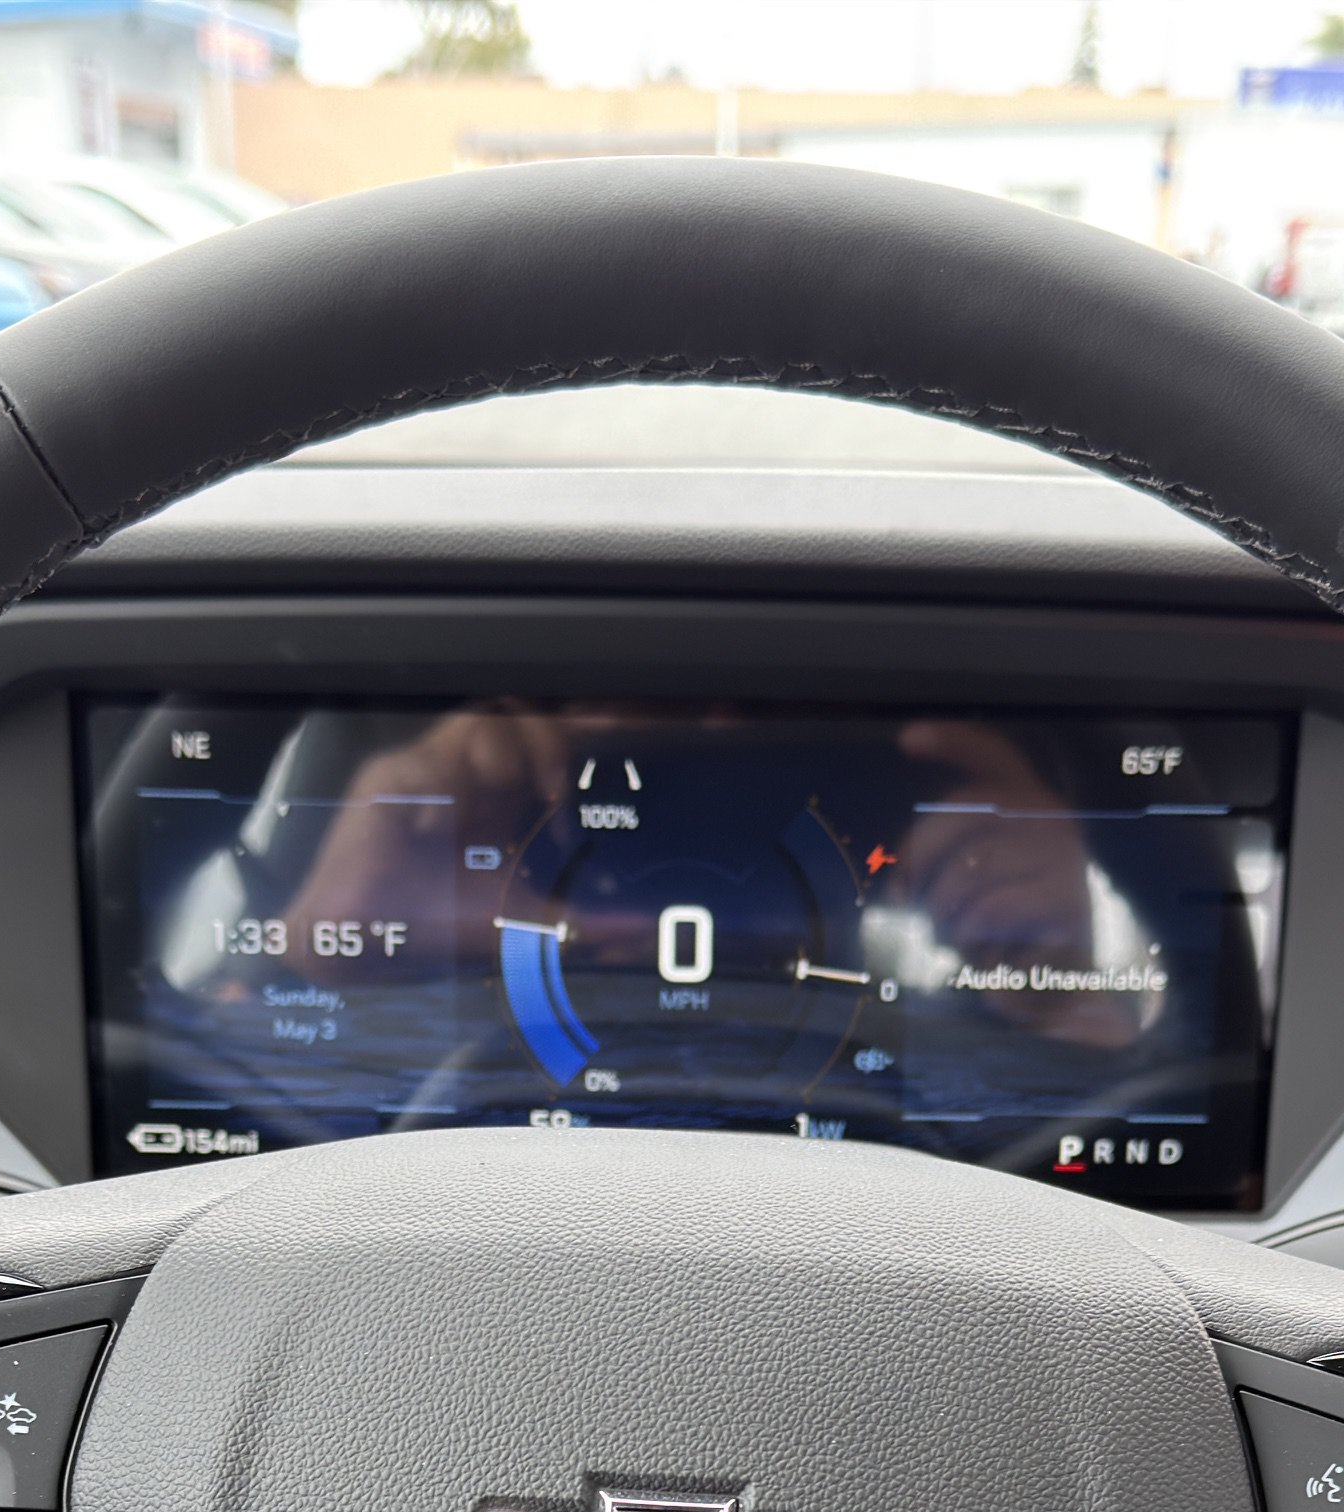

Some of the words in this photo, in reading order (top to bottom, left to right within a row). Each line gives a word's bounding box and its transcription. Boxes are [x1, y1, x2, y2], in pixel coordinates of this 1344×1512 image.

[172, 731, 210, 759] NE
[1122, 747, 1182, 774] 65°F
[579, 805, 638, 829] 100%
[213, 919, 287, 954] 1:33
[313, 920, 363, 956] 65
[370, 920, 408, 956] °F
[658, 905, 712, 983] 0
[879, 979, 898, 1002] 0
[958, 966, 1026, 990] Audio
[1030, 966, 1167, 991] Unavailable
[262, 983, 346, 1012] Sunday,
[659, 991, 710, 1011] MPH
[273, 1018, 318, 1045] May
[320, 1018, 337, 1040] 3
[584, 1069, 621, 1092] 0%
[184, 1129, 258, 1154] 154mi
[1059, 1136, 1083, 1164] P
[1094, 1139, 1114, 1164] R
[1127, 1139, 1148, 1164] N
[1159, 1139, 1183, 1164] D
